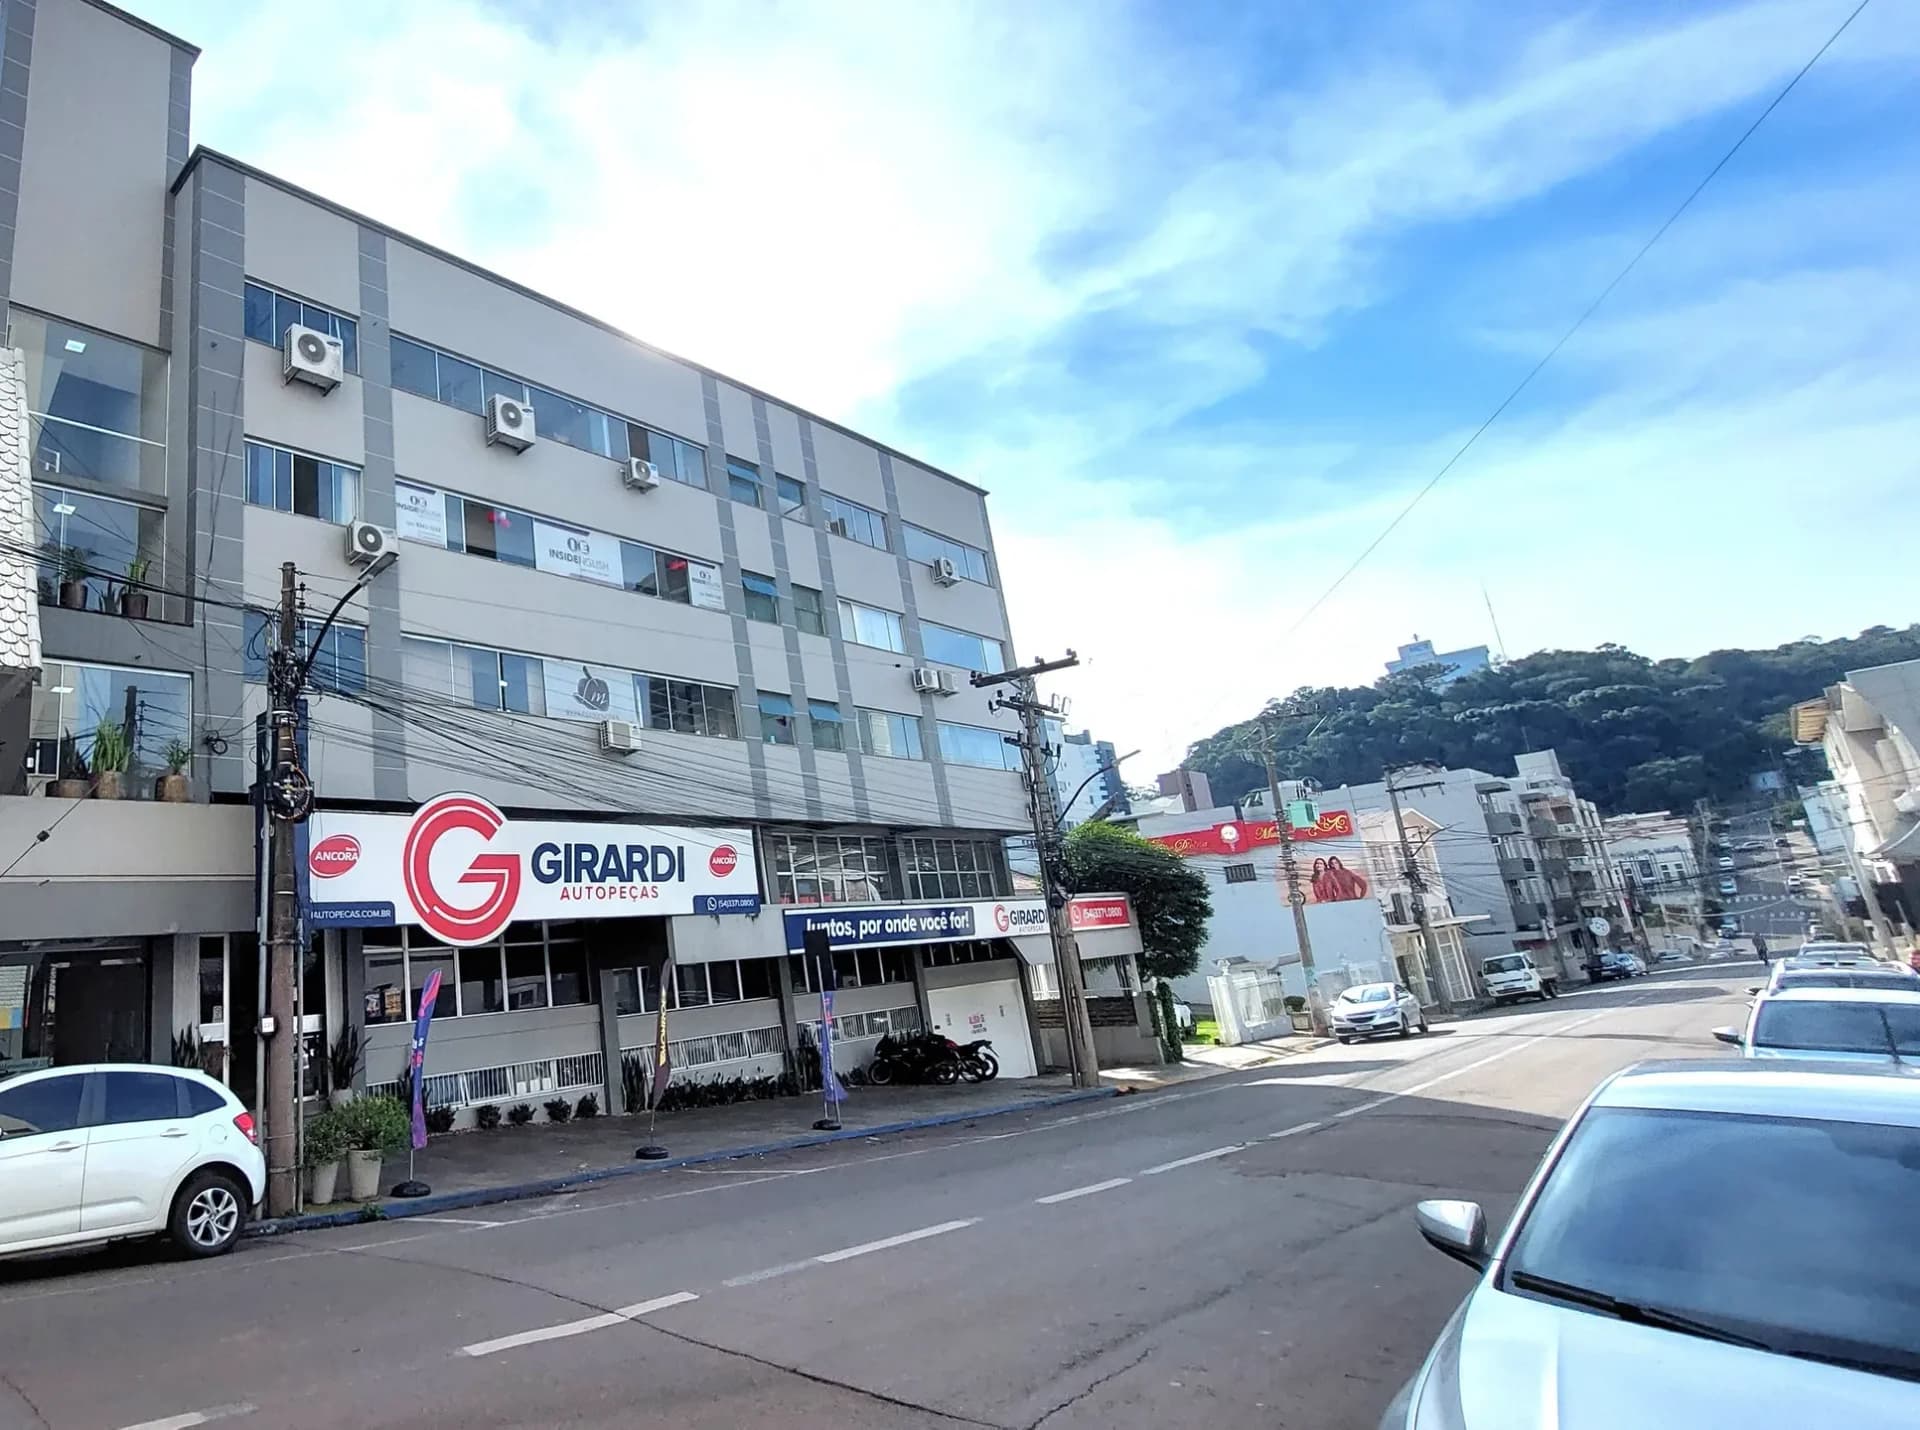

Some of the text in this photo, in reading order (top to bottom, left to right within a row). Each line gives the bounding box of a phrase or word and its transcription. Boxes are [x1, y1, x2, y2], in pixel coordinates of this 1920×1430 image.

[314, 851, 358, 861] ANCORA
[531, 842, 685, 884] GIRARDI
[711, 857, 737, 865] ANCORA
[560, 886, 659, 902] AUTOPEÇAS
[860, 920, 881, 939] por
[885, 914, 917, 933] onde
[919, 911, 948, 931] você
[949, 911, 970, 929] for!
[1010, 908, 1049, 926] GIRARDI
